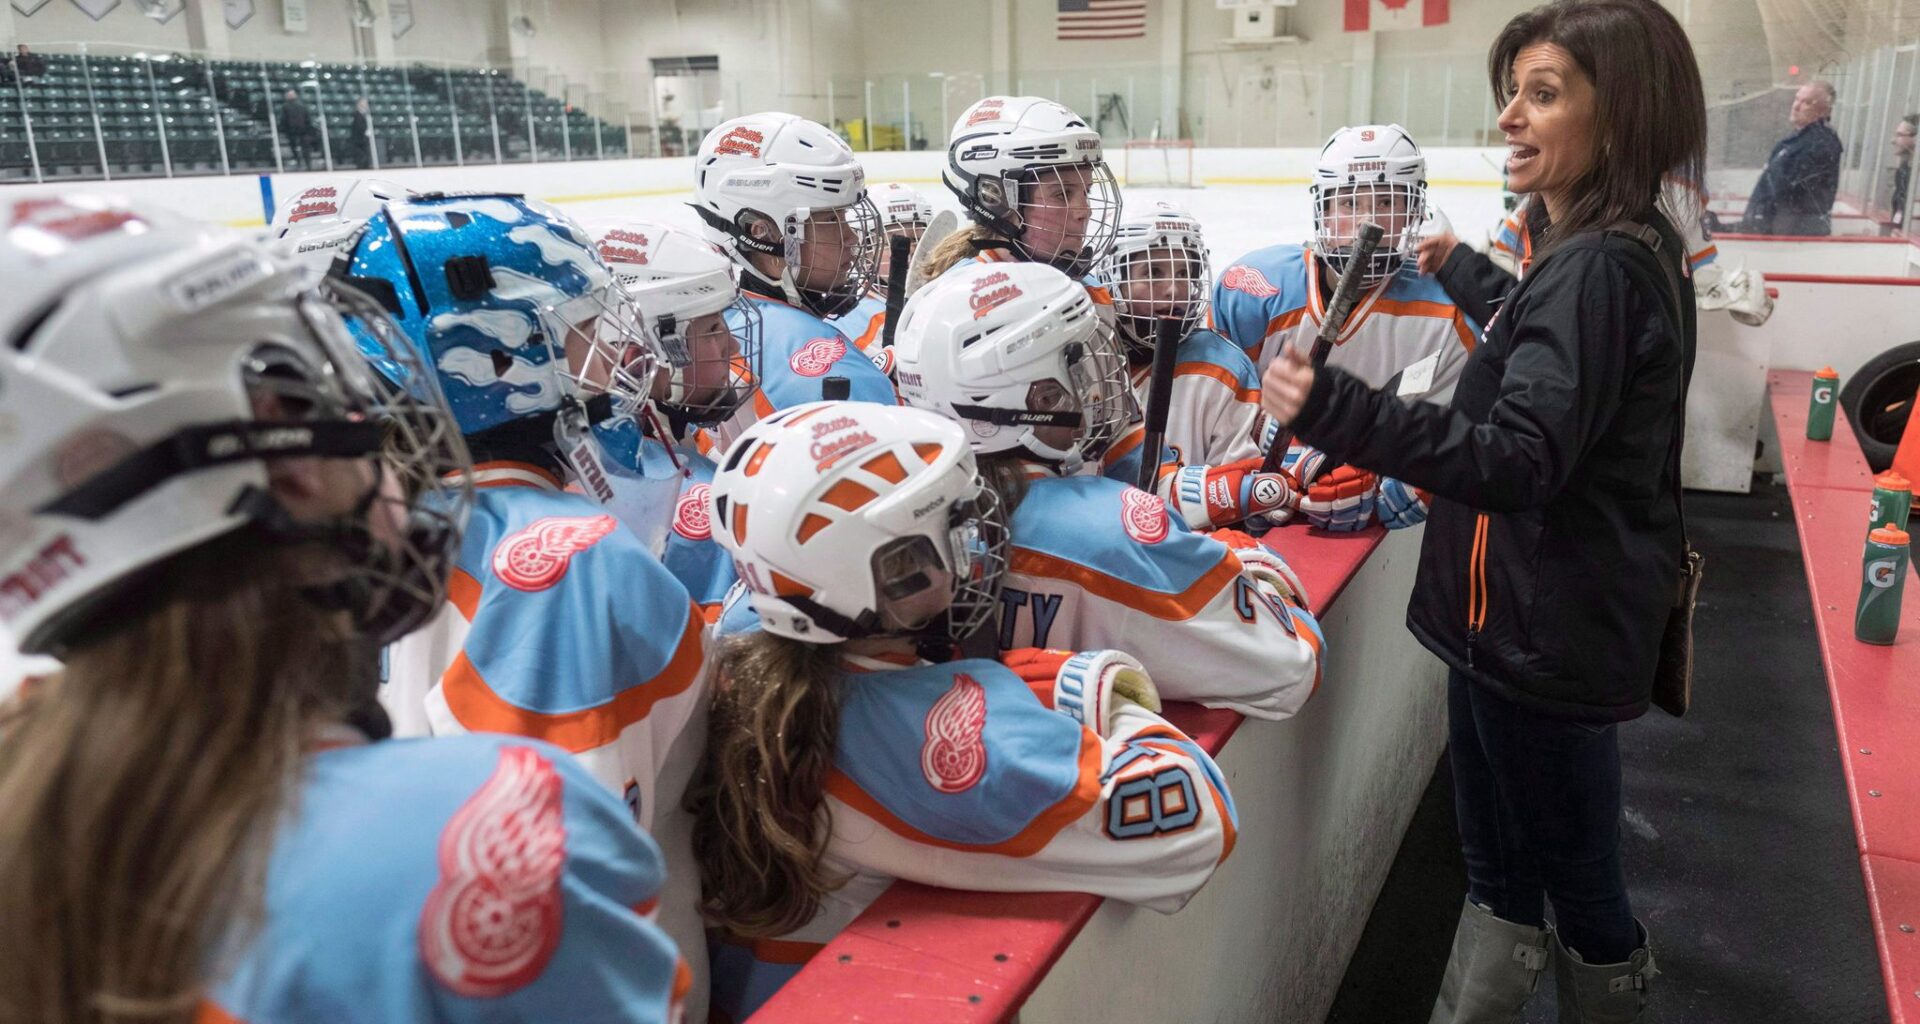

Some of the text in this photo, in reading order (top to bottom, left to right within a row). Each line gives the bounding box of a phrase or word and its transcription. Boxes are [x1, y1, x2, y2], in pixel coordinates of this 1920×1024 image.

[1347, 162, 1387, 173] DETROIT
[1155, 221, 1190, 231] DETROIT
[739, 235, 774, 252] BAUER
[1815, 387, 1832, 404] G
[1011, 414, 1054, 422] AUER
[574, 444, 614, 504] DETROIT
[913, 496, 945, 520] Reebok
[1868, 561, 1896, 588] G
